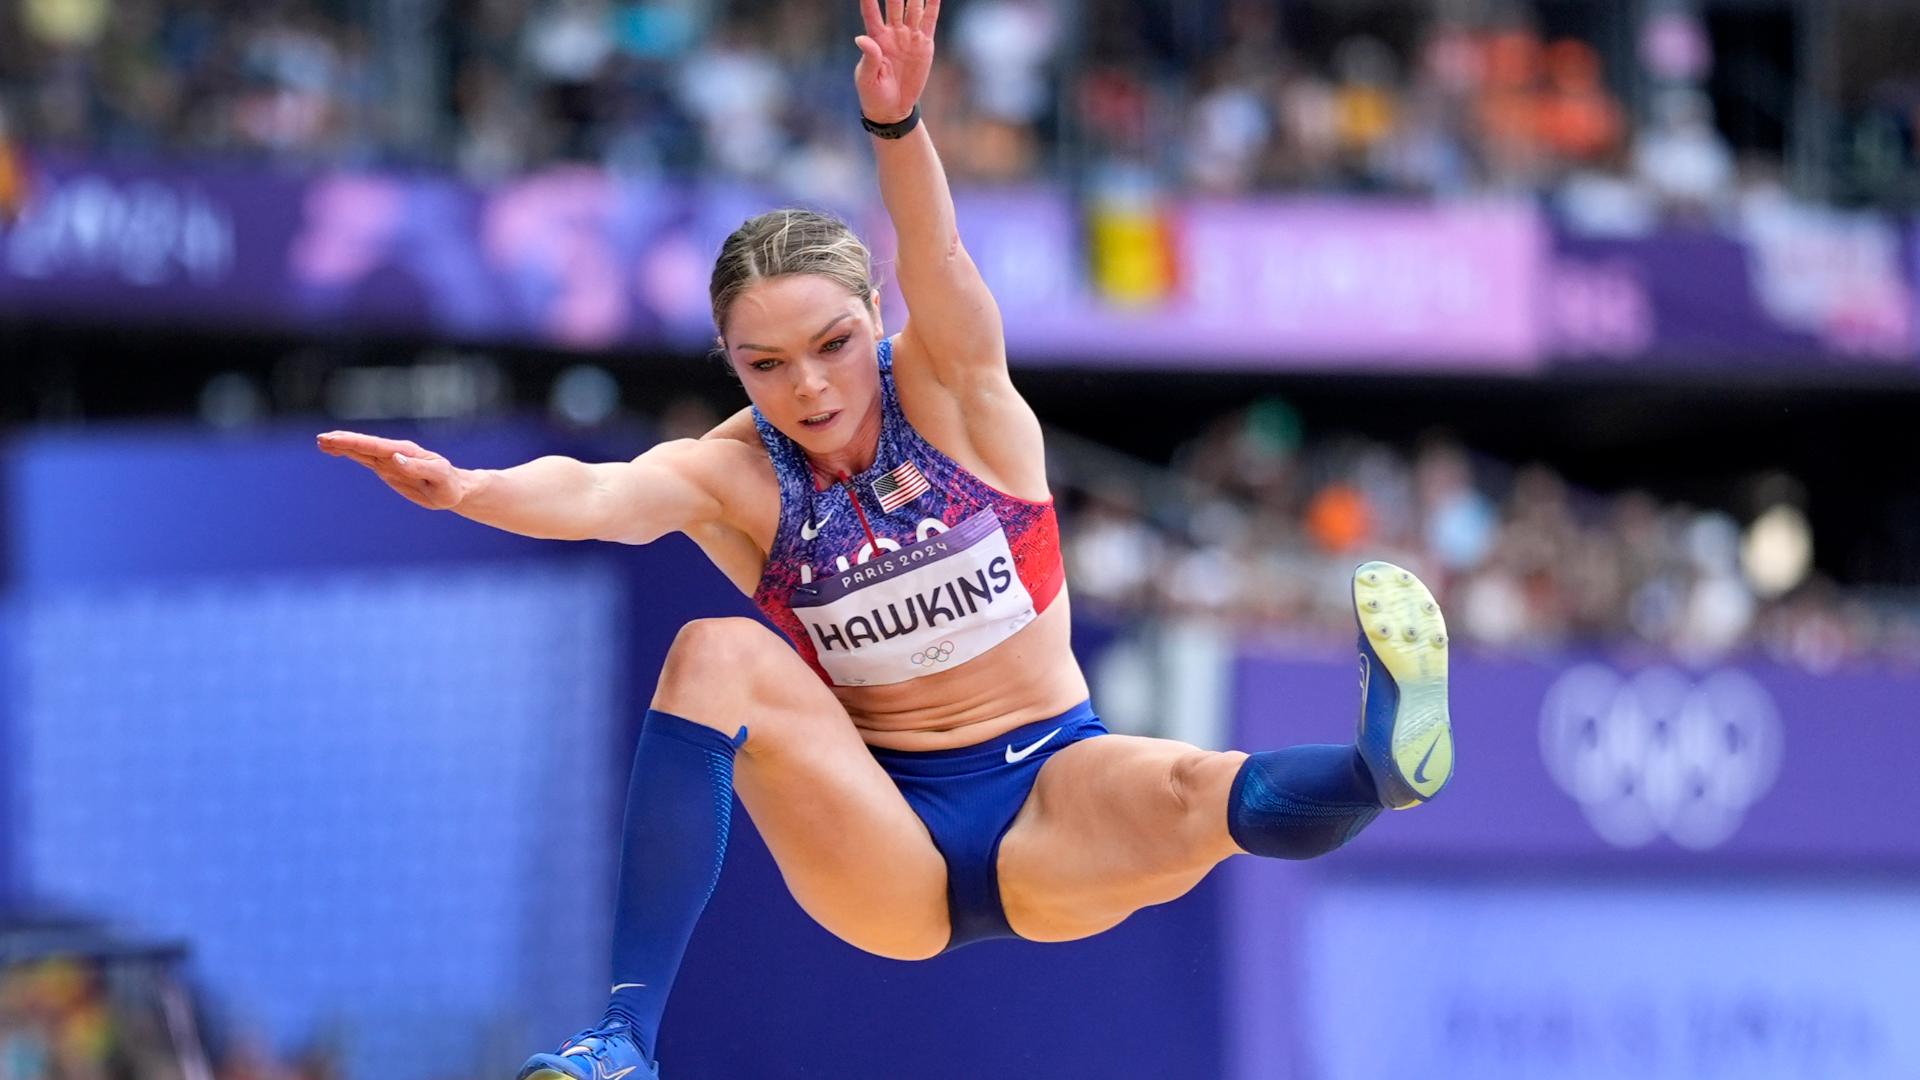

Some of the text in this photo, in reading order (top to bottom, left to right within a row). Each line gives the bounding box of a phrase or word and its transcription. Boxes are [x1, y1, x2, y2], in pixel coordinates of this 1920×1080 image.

[841, 560, 895, 589] PARIS
[899, 541, 949, 567] 2024
[812, 555, 1012, 651] HAWKINS
